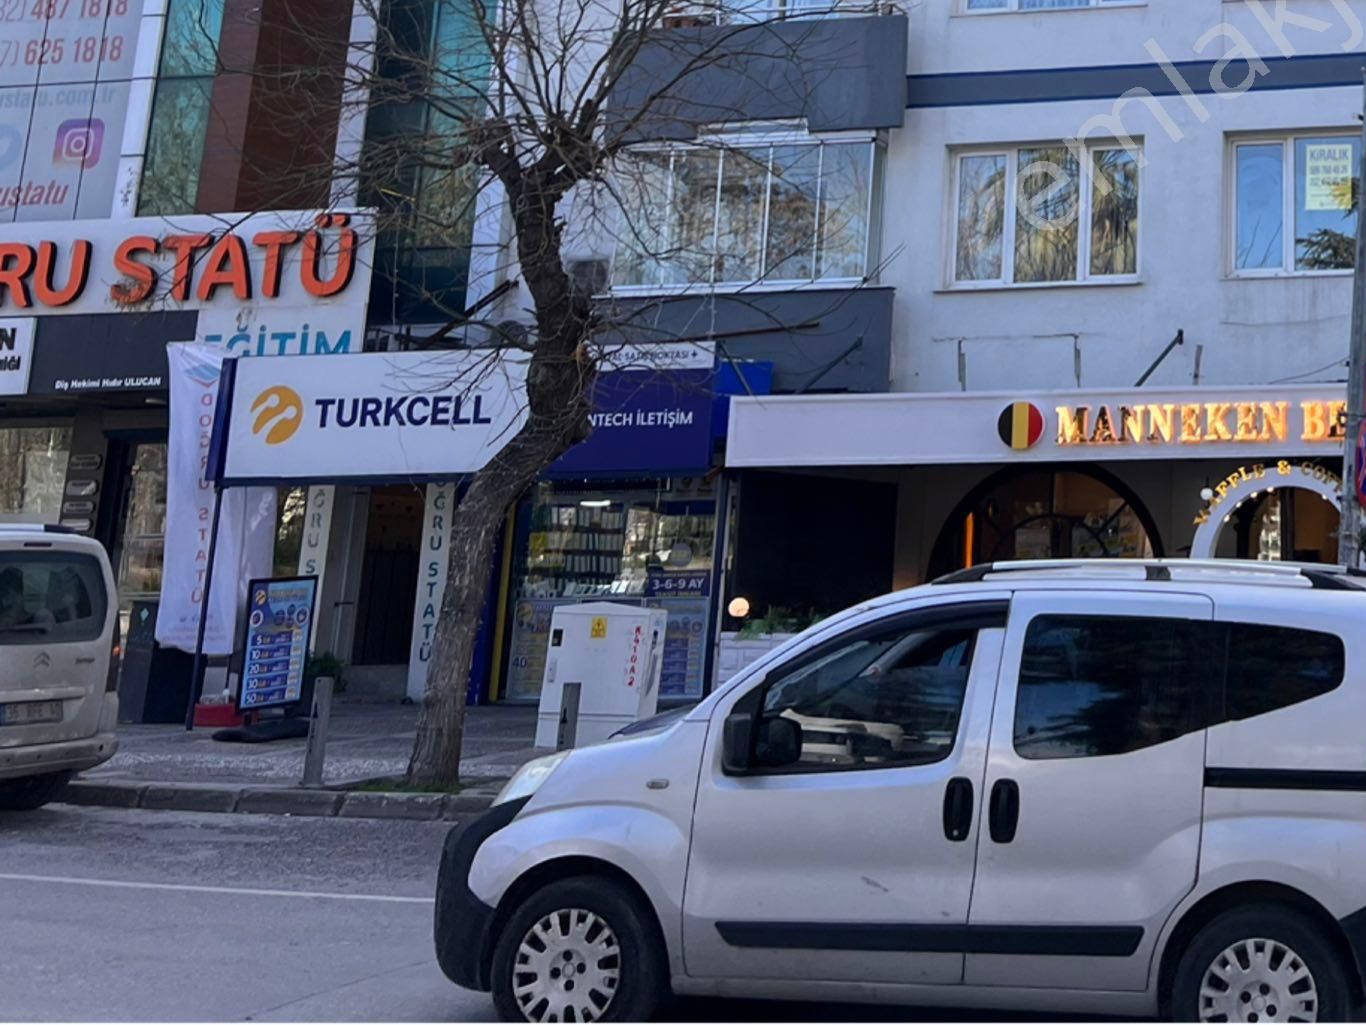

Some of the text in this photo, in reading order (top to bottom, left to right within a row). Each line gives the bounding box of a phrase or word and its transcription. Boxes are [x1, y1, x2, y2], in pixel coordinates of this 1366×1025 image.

[24, 38, 64, 65] 625
[74, 35, 123, 64] 1818
[111, 214, 358, 304] STATÜ
[124, 376, 161, 387] ULUCAN
[315, 395, 492, 428] TURKCELL
[636, 408, 693, 428] İLETİŞİM
[1055, 400, 1289, 446] MANNEKEN
[1277, 460, 1292, 475] &
[652, 578, 705, 590] 3-6-9 AY
[512, 656, 528, 669] 40
